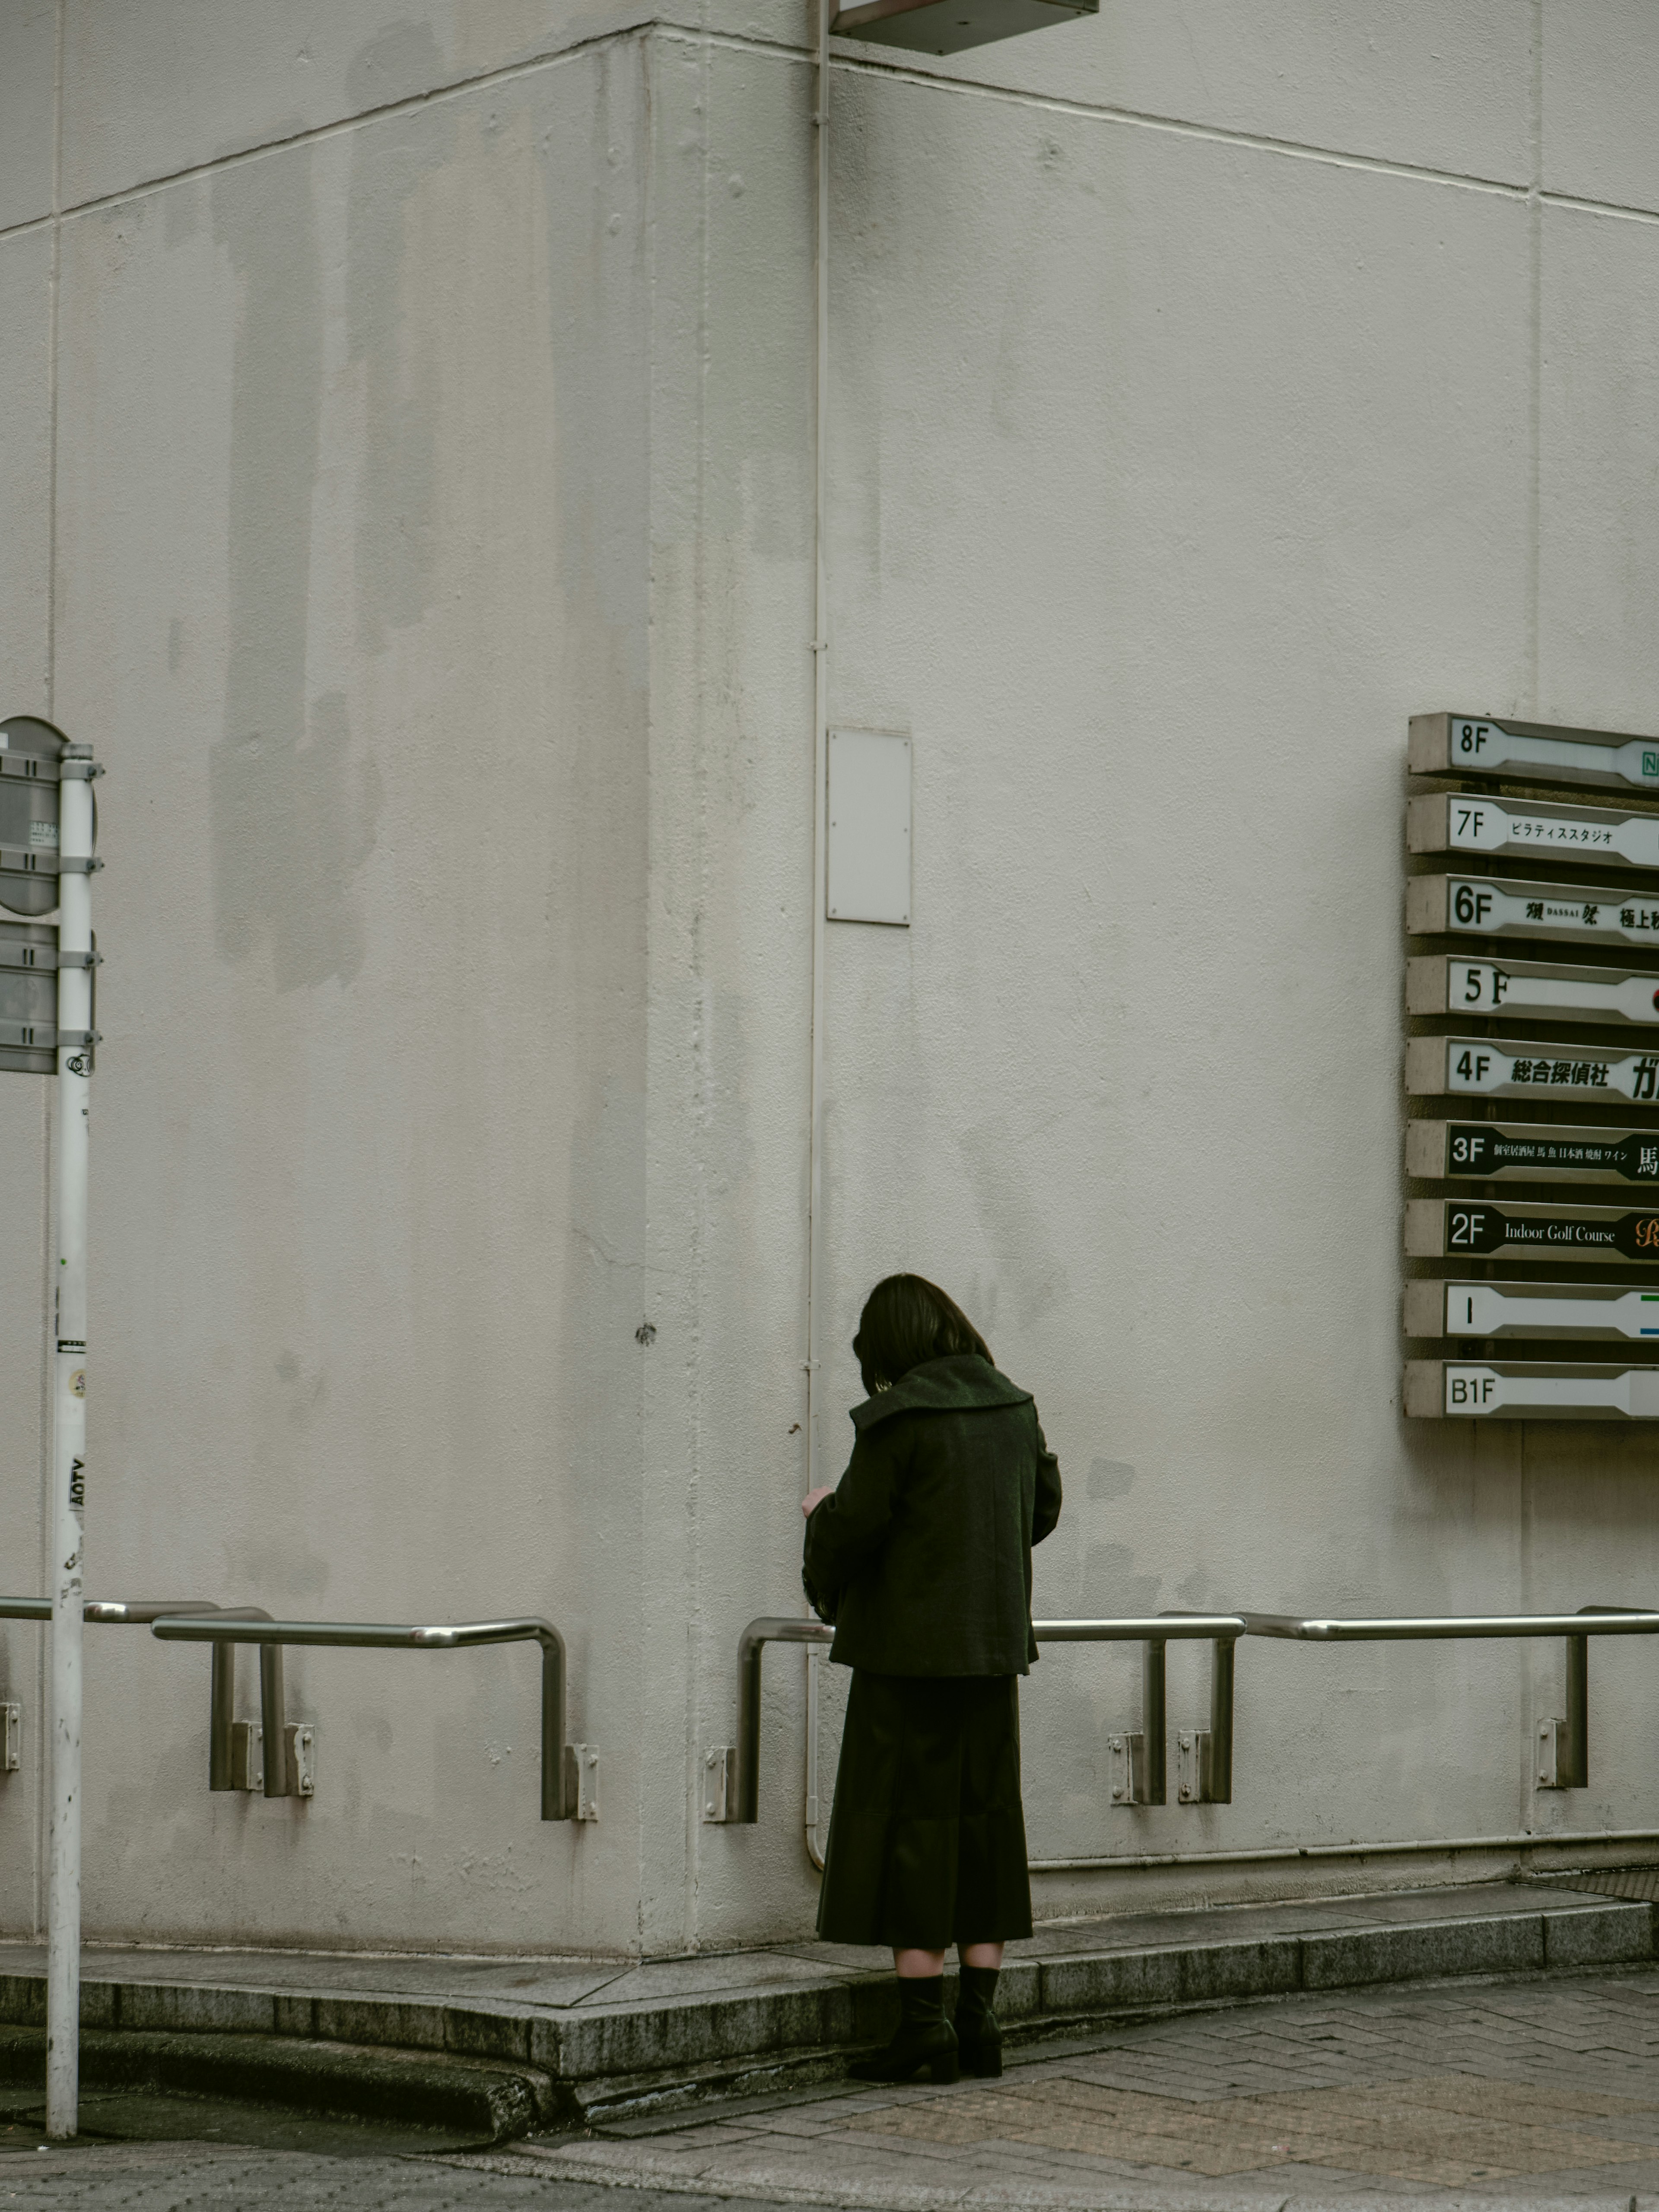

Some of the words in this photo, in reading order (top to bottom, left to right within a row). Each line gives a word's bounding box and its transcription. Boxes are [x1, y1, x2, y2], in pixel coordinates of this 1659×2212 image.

[1461, 725, 1489, 753] 8F
[1458, 810, 1484, 837] 7F
[1512, 822, 1613, 844] ピラティススタジオ
[1455, 885, 1493, 924] 6F
[1547, 907, 1579, 917] DASSAI
[1465, 969, 1511, 1004] 5F
[1456, 1051, 1490, 1081] 4F
[1511, 1059, 1609, 1087] 総合探偵社
[1633, 1058, 1659, 1100] ガ
[1453, 1137, 1484, 1162] 3F
[1605, 1151, 1627, 1160] ワイン
[1637, 1147, 1658, 1175] 馬
[1451, 1213, 1485, 1244] 2F
[1505, 1223, 1545, 1239] Indoor
[1548, 1225, 1574, 1240] Golf
[1576, 1227, 1615, 1242] Course
[1452, 1378, 1495, 1403] B1F
